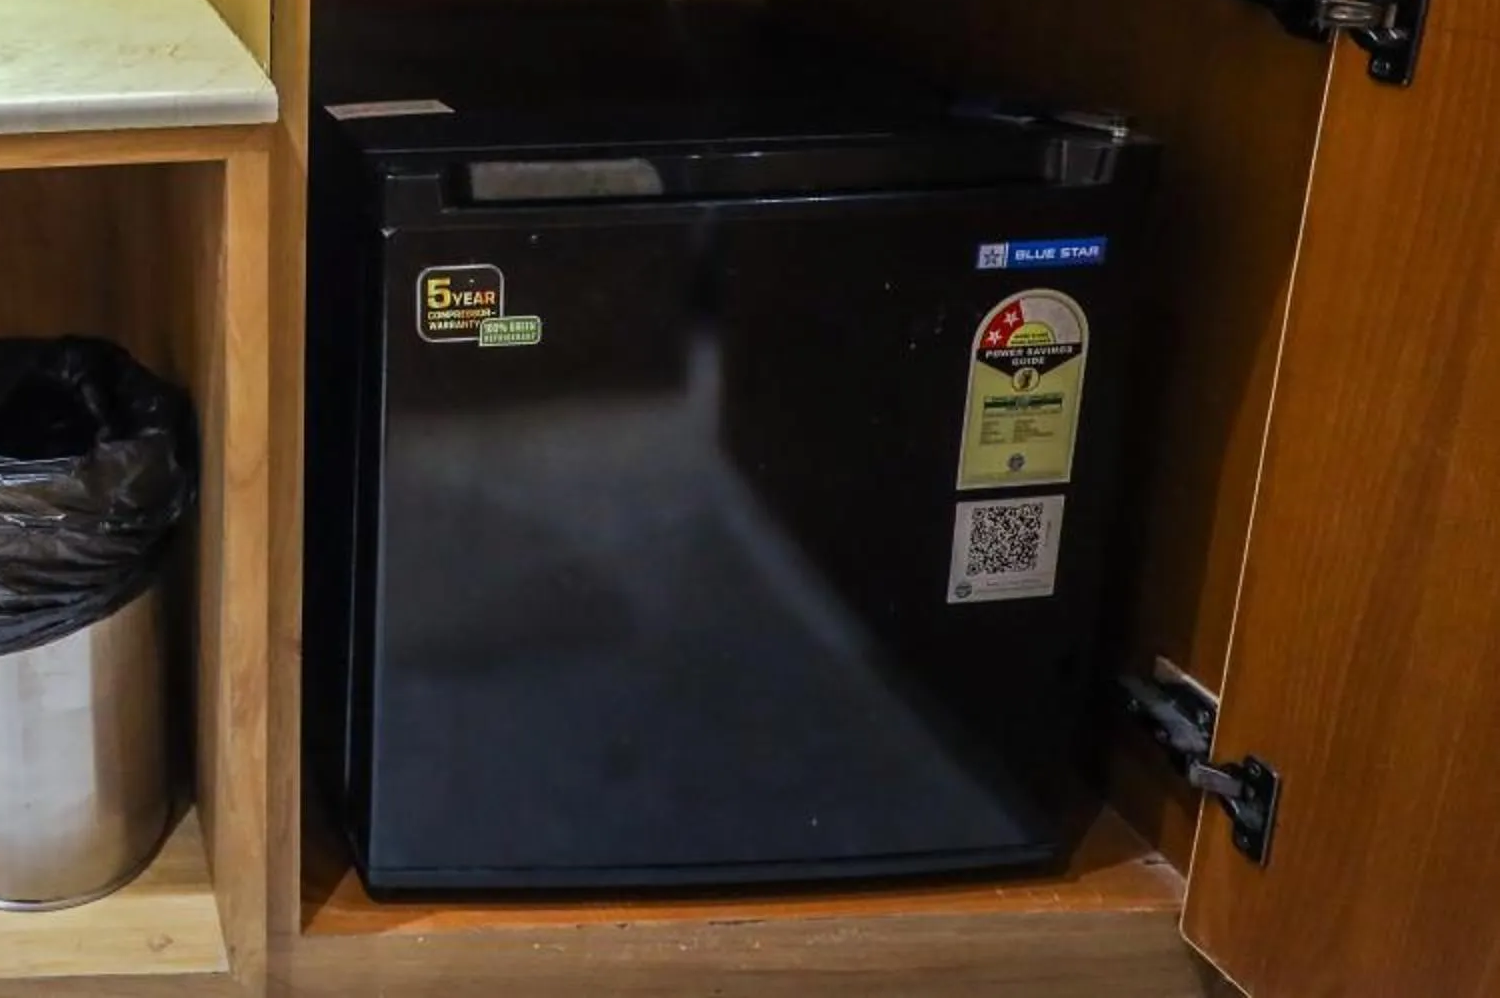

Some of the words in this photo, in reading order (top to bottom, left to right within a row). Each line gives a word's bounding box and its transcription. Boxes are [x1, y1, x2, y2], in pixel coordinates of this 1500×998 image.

[1014, 248, 1056, 262] BLUE
[1060, 245, 1100, 259] STAR
[427, 277, 451, 309] 5
[452, 291, 497, 306] YEAR
[1011, 356, 1045, 366] GUIDE
